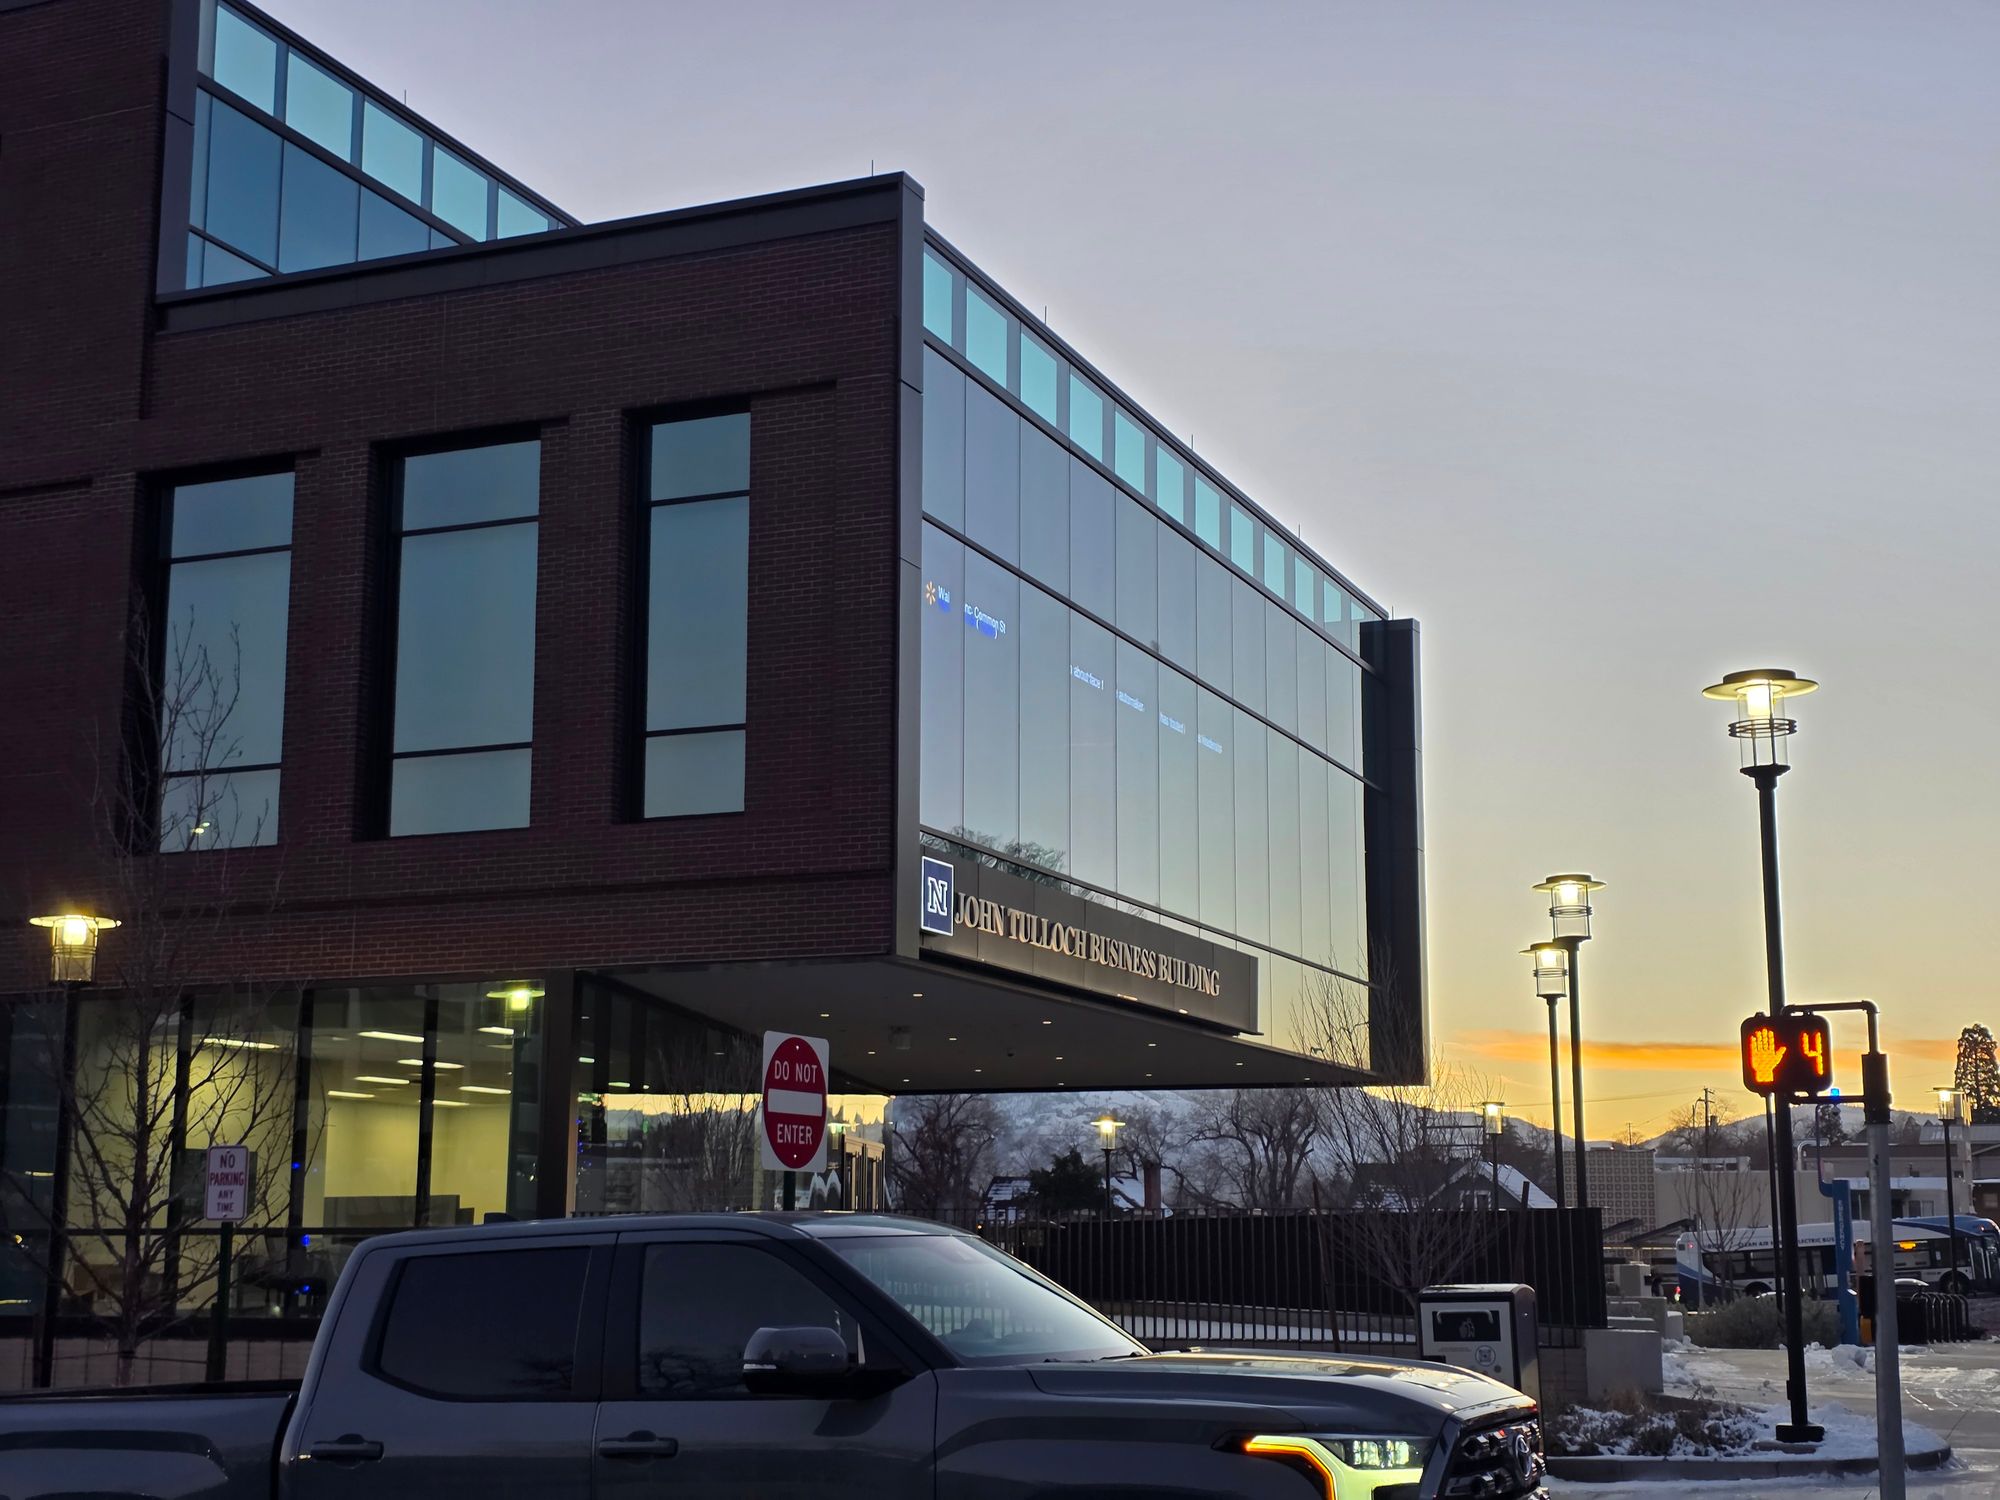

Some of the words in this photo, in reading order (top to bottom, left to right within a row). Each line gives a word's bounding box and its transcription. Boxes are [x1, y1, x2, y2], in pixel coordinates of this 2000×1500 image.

[927, 877, 948, 916] N
[955, 892, 1006, 937] JOHN
[1007, 907, 1087, 960] TULLOCH
[1089, 933, 1157, 980] BUSINESS
[1158, 954, 1220, 996] BUILDING
[1802, 1032, 1824, 1075] 4
[774, 1060, 790, 1081] DO
[795, 1063, 817, 1083] NOT
[777, 1123, 813, 1145] ENTER
[220, 1154, 235, 1168] NO
[209, 1172, 245, 1186] PARKING
[218, 1190, 234, 1199] ANY
[216, 1202, 234, 1212] TIME
